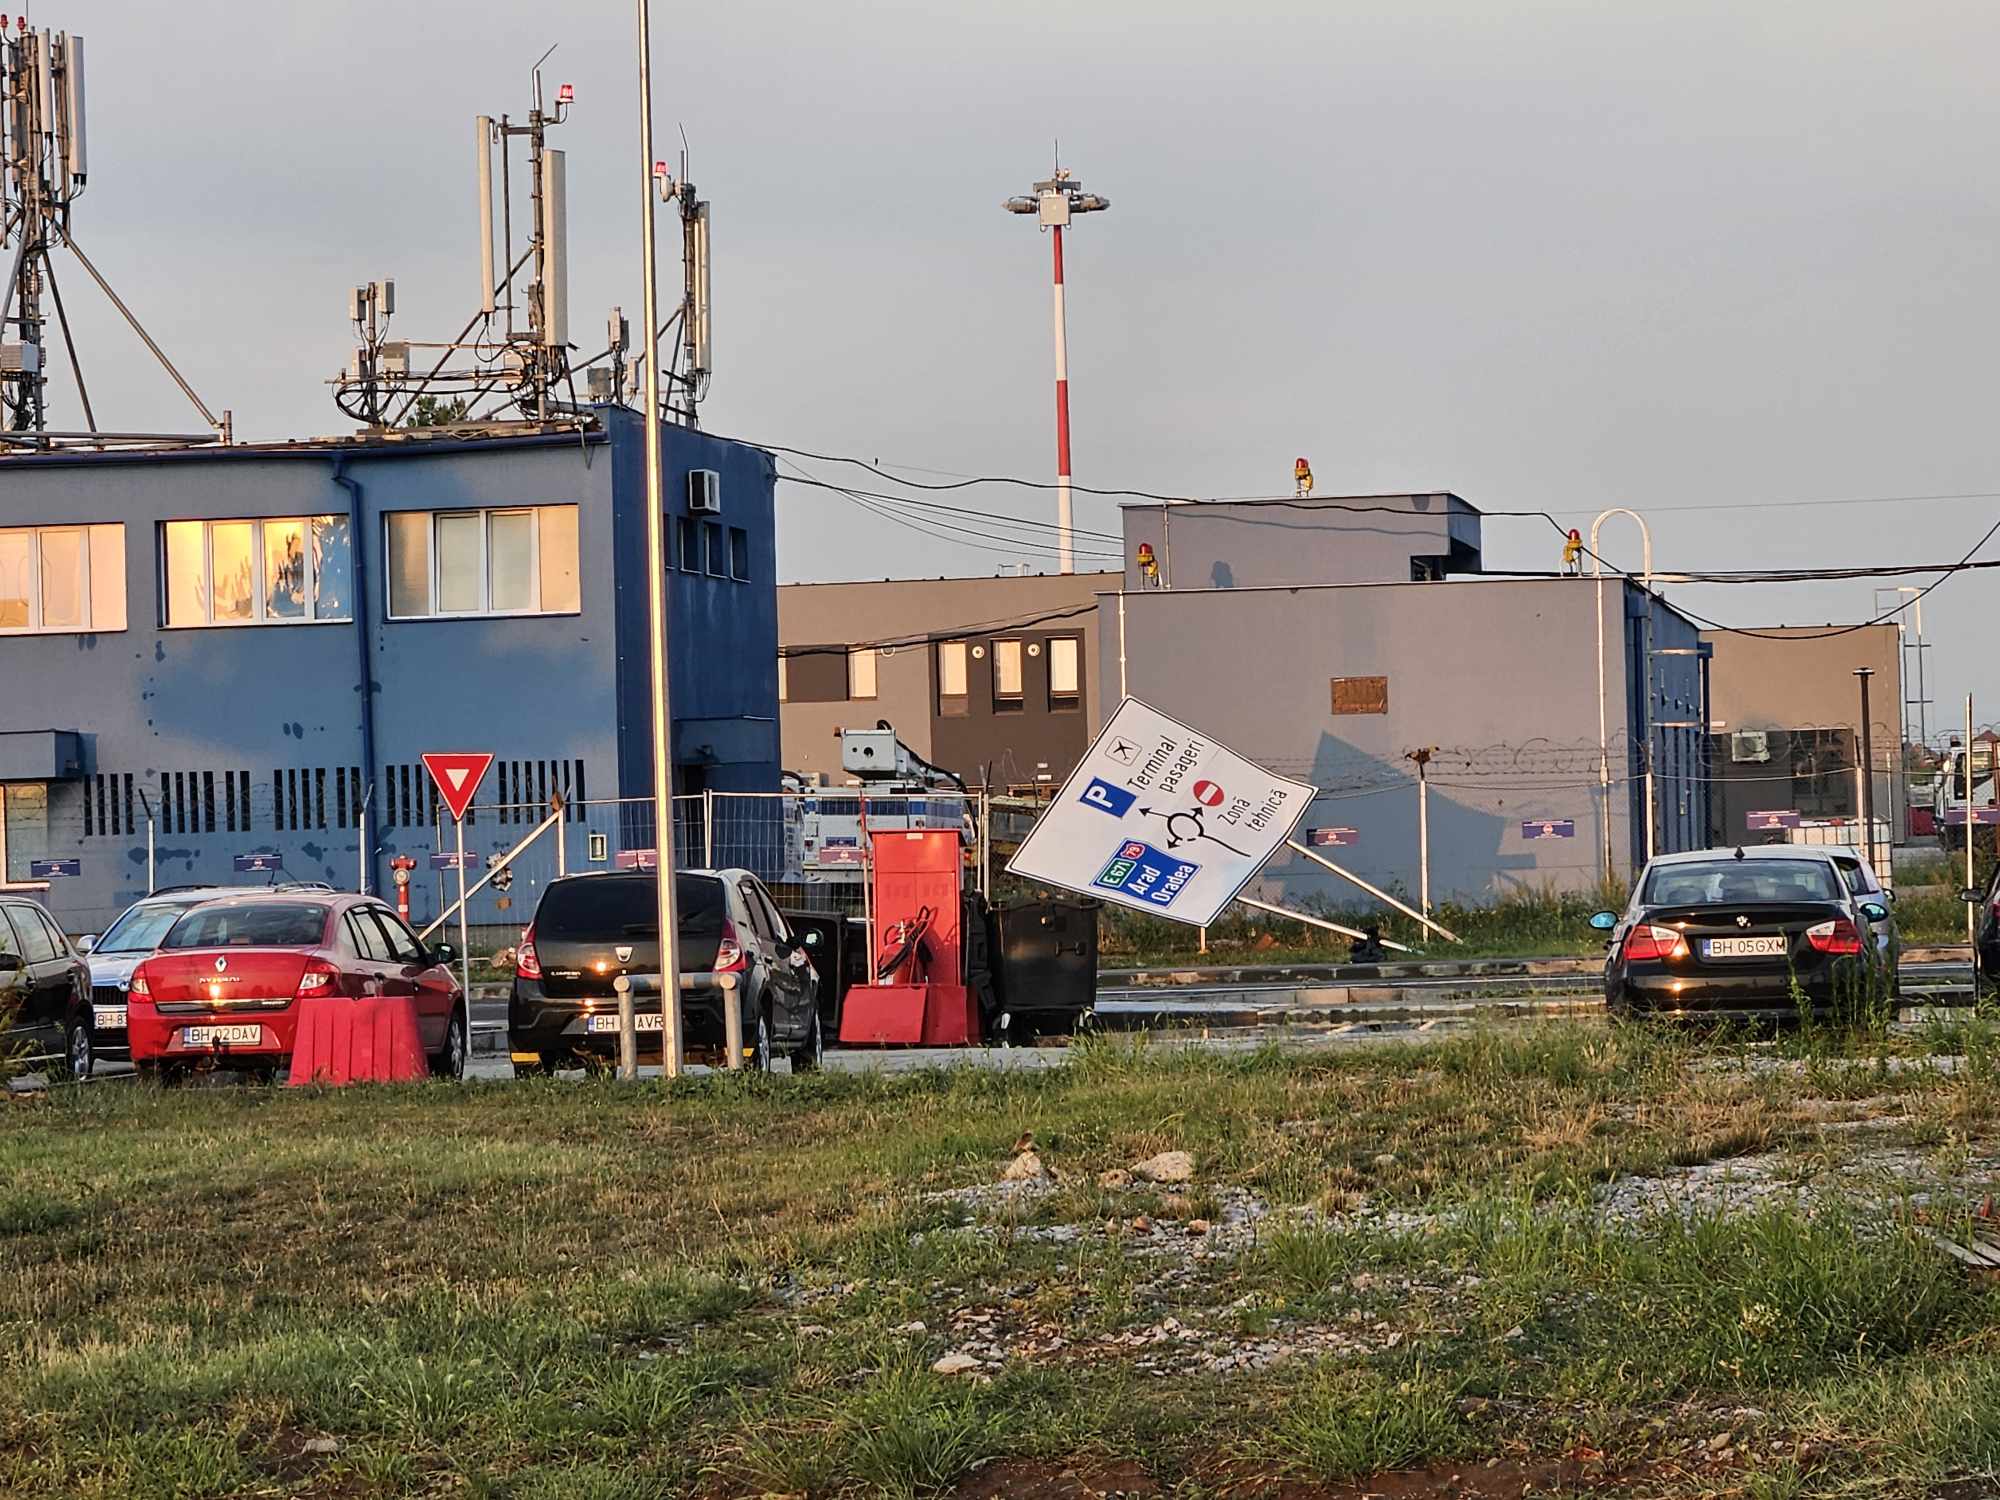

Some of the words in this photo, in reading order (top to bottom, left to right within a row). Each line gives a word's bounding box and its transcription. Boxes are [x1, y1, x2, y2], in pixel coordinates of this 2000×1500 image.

[1126, 735, 1178, 790] Terminal
[1159, 738, 1204, 794] pasageri
[1085, 785, 1113, 808] P
[1217, 796, 1250, 825] Zonă
[1244, 789, 1288, 832] tehnică
[1102, 875, 1120, 884] E
[1111, 861, 1131, 877] 671
[1127, 864, 1161, 896] Arad
[1151, 865, 1194, 902] Oradea
[1712, 941, 1733, 954] BH
[98, 1014, 112, 1025] BH
[596, 1017, 615, 1030] BH
[191, 1028, 210, 1041] BH
